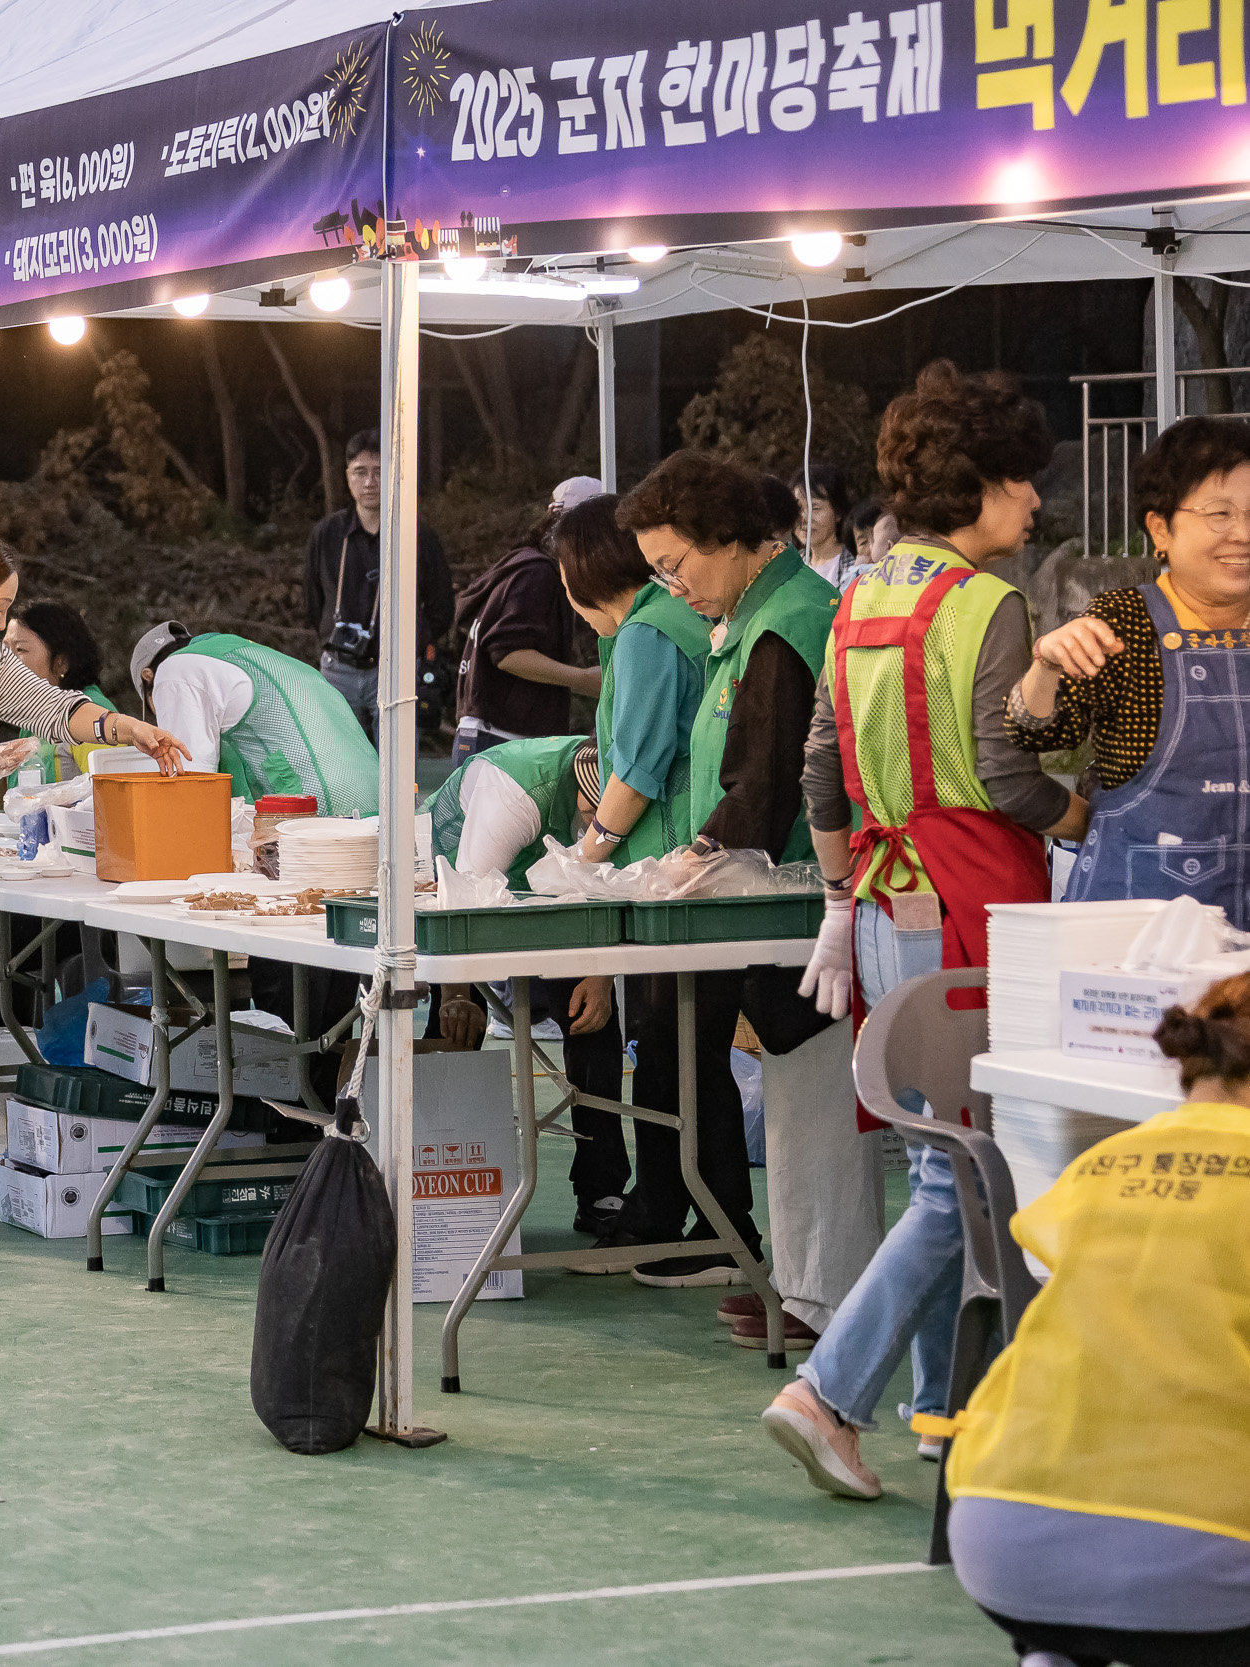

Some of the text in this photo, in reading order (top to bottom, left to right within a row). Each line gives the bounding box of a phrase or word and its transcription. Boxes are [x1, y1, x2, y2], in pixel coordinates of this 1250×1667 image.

[450, 66, 544, 162] 2025
[550, 50, 649, 155] 군자
[658, 1, 943, 147] 한마당축제
[1201, 779, 1236, 793] Jean
[464, 1172, 495, 1194] CUP
